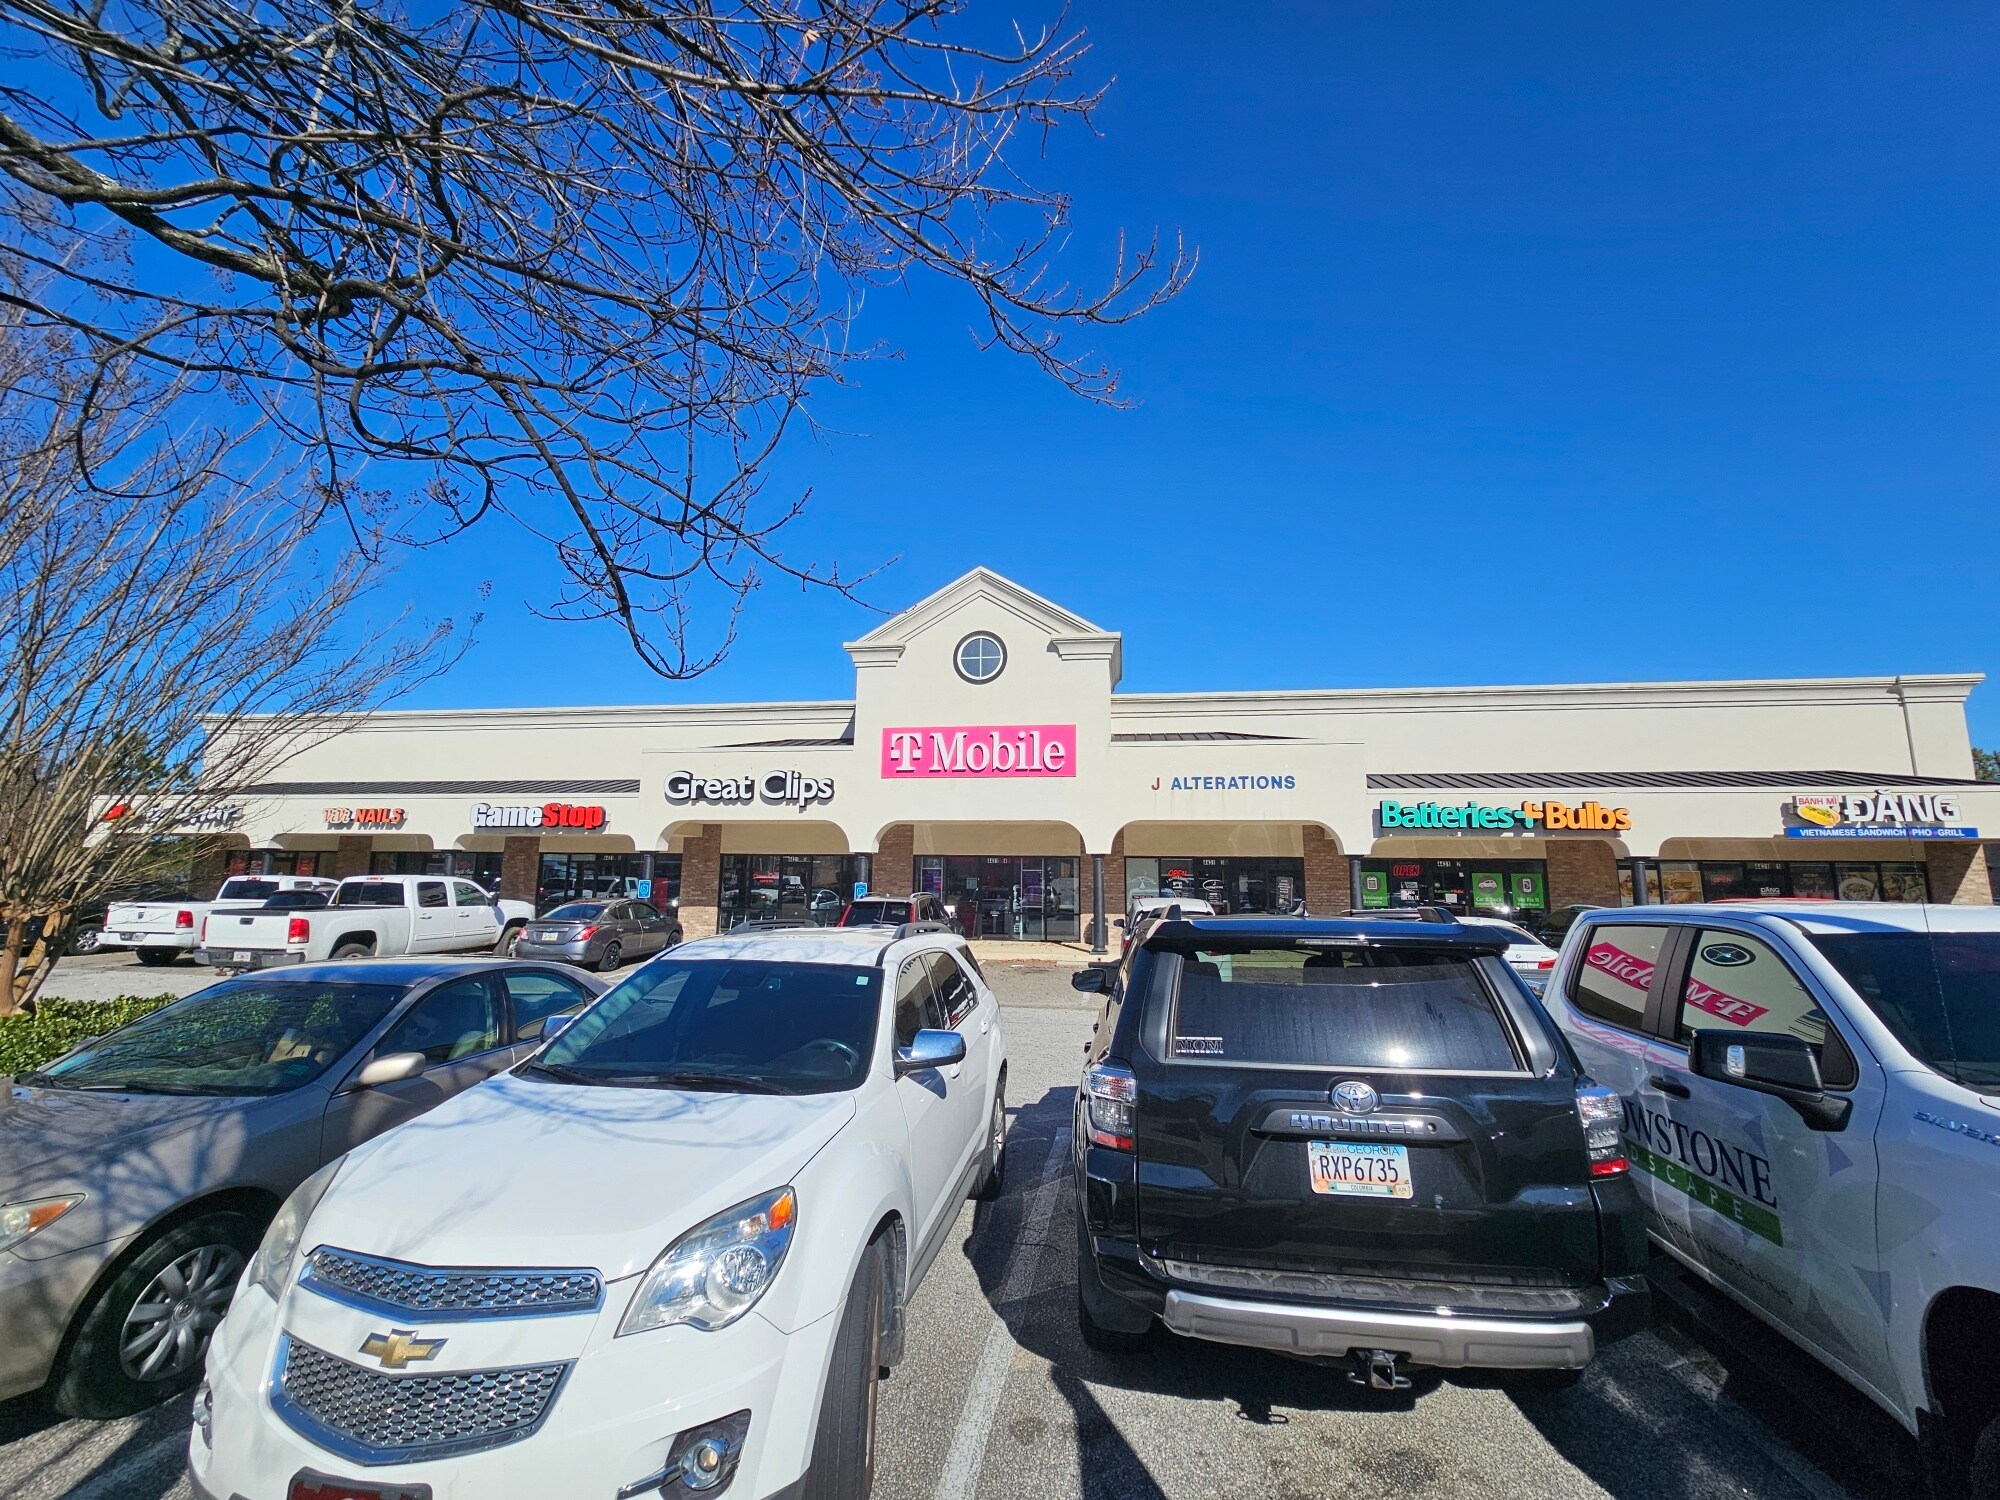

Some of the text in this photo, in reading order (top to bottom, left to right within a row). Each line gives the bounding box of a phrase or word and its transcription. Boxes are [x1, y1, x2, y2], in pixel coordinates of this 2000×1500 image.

[890, 730, 1066, 772] T Mobile
[664, 770, 834, 807] Great Clips
[1151, 775, 1296, 791] J ALTERATIONS
[355, 807, 404, 824] NAILS
[470, 803, 606, 829] GameStop
[1799, 828, 1966, 837] VIETNAMESE SANDWICH PHO GRILL
[1168, 869, 1187, 877] OPEN
[1393, 865, 1420, 876] OPEN
[1175, 1040, 1224, 1051] MOM
[1346, 1144, 1401, 1156] GEORGIA
[1320, 1155, 1399, 1183] RXP6735
[1350, 1184, 1374, 1192] COLUMBIA
